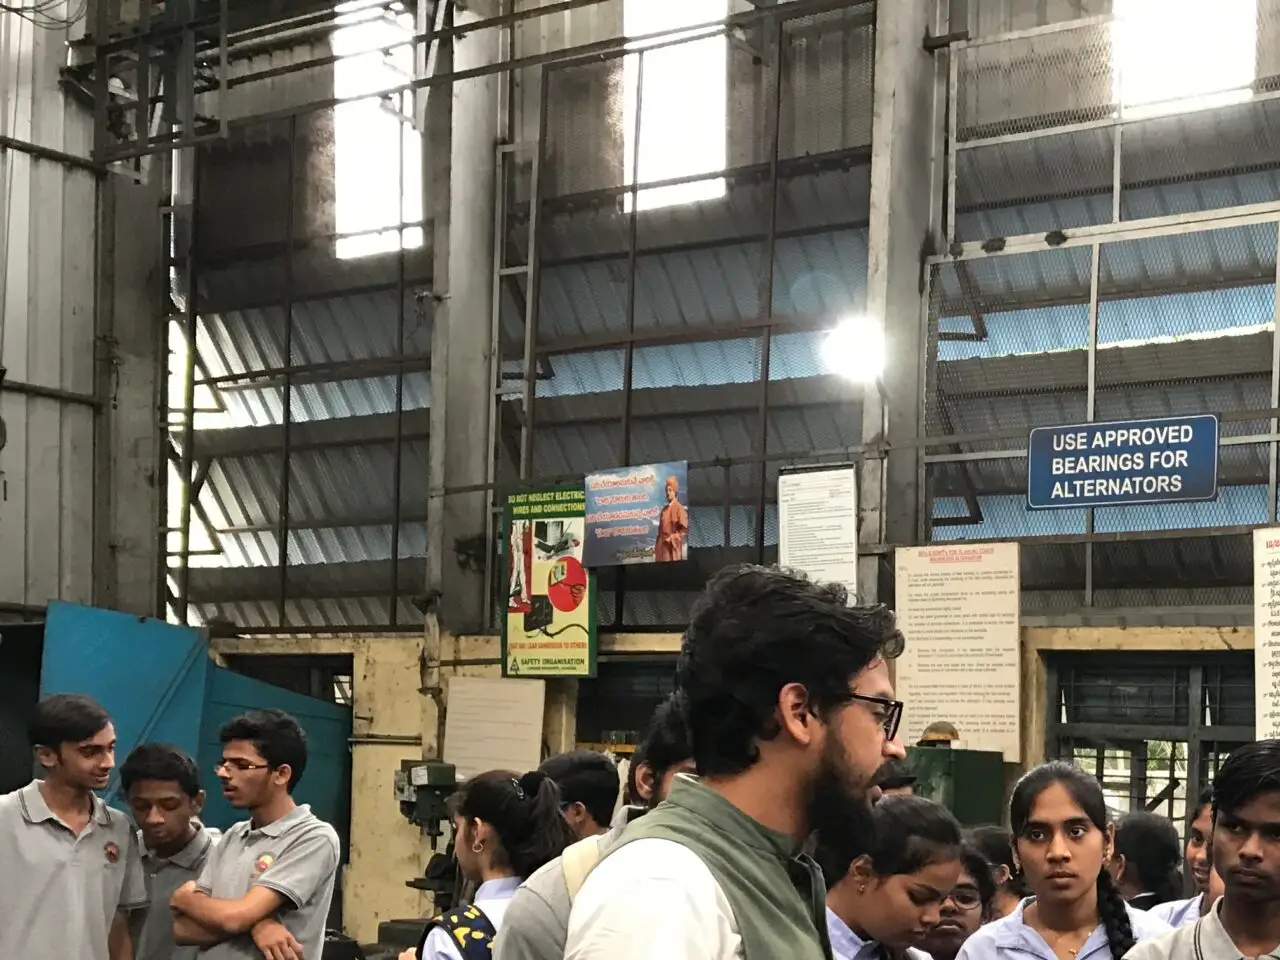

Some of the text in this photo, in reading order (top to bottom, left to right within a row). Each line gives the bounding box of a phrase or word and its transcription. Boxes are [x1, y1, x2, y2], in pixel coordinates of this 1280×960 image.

[1053, 425, 1193, 451] USE APPROVED
[1052, 450, 1188, 475] BEARINGS FOR
[1051, 475, 1182, 499] ALTERNATORS
